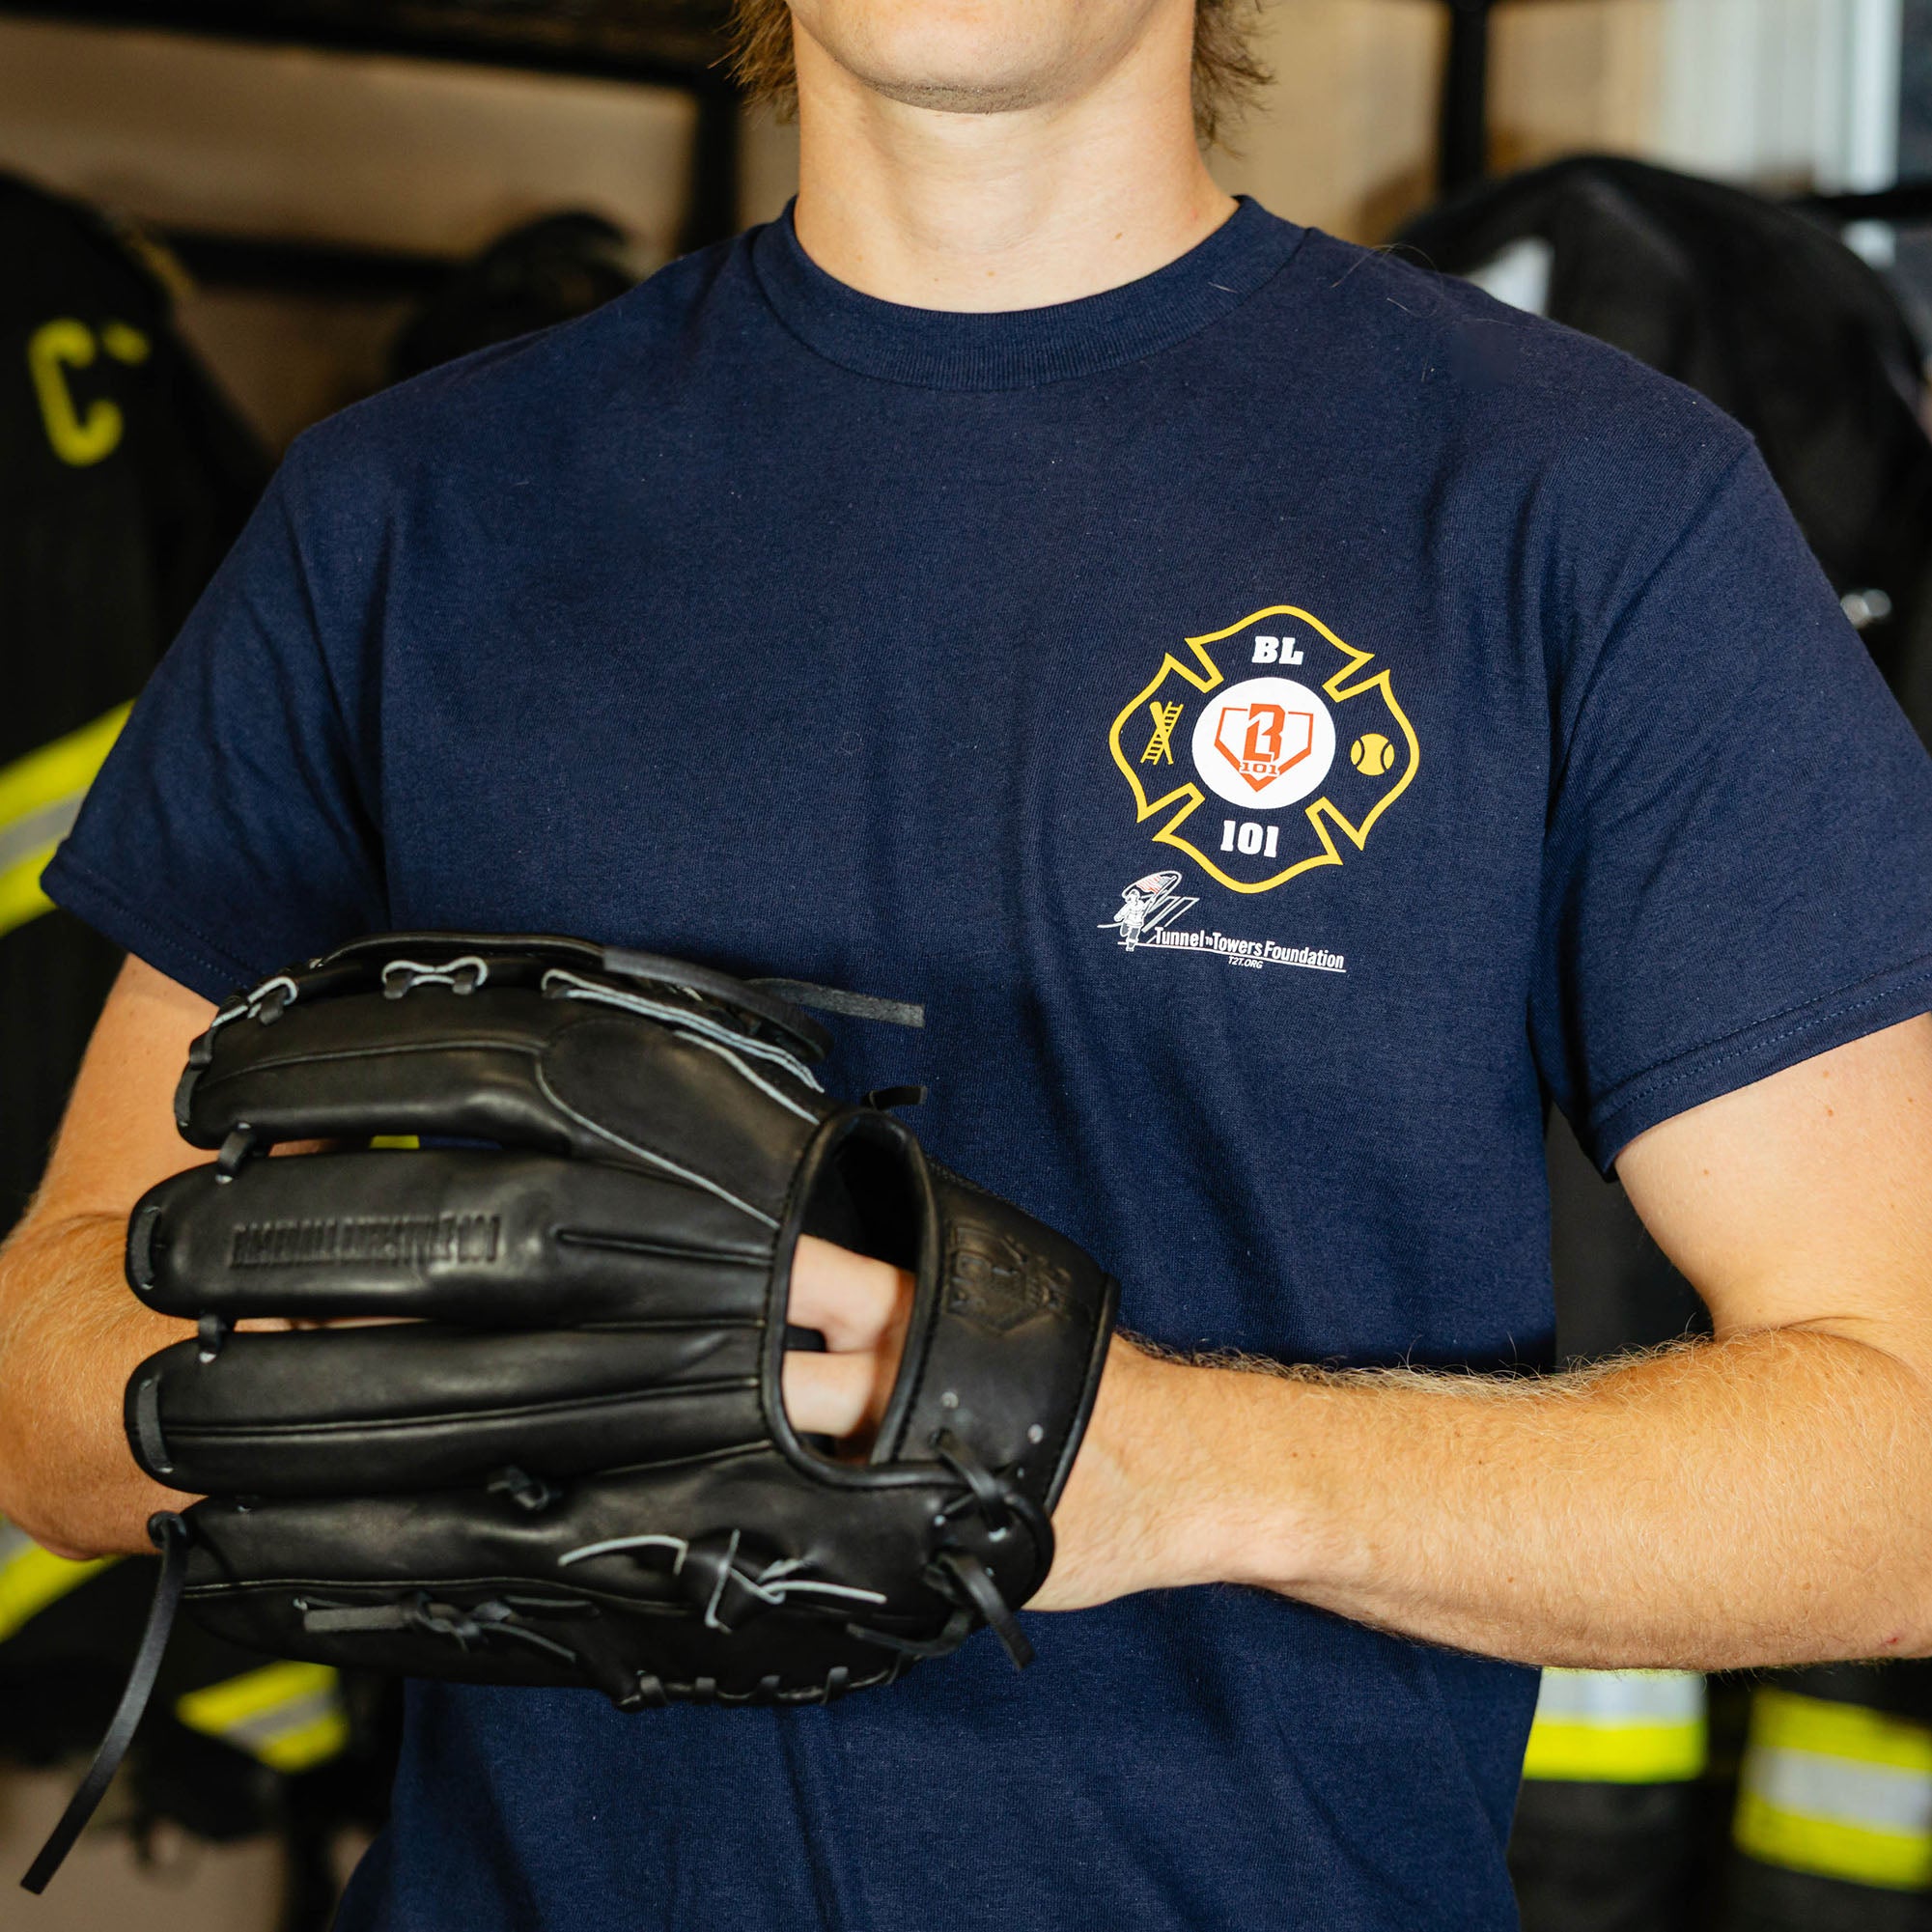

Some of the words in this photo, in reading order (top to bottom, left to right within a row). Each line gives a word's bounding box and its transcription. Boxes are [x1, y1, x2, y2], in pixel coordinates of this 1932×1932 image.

[1251, 636, 1303, 665] BL
[1240, 762, 1279, 775] 101
[1220, 820, 1279, 857] 101
[1154, 927, 1205, 947] Tunnel
[1213, 932, 1263, 956] Towers
[1264, 941, 1344, 968] Foundation
[1228, 956, 1263, 969] T2T.ORG
